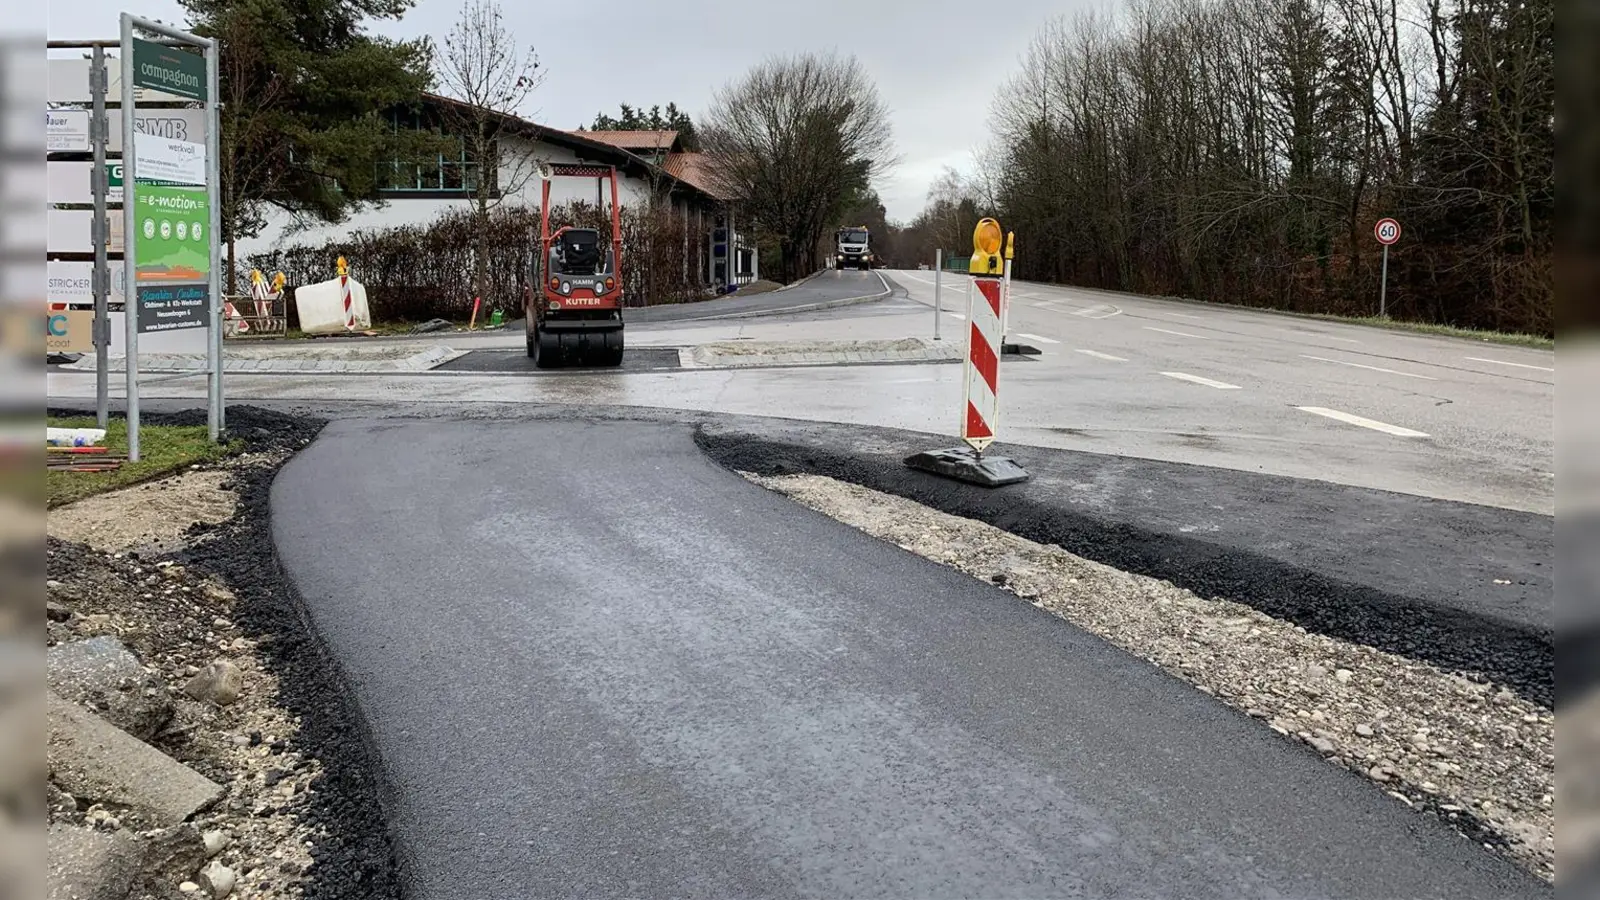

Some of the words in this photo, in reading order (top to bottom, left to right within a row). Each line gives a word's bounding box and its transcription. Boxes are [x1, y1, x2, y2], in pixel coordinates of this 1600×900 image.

[141, 63, 199, 88] compagnon
[148, 194, 197, 209] e-motion
[1380, 225, 1395, 237] 60
[48, 278, 90, 288] STRICKER
[145, 320, 202, 331] www.bavarian-customs.de
